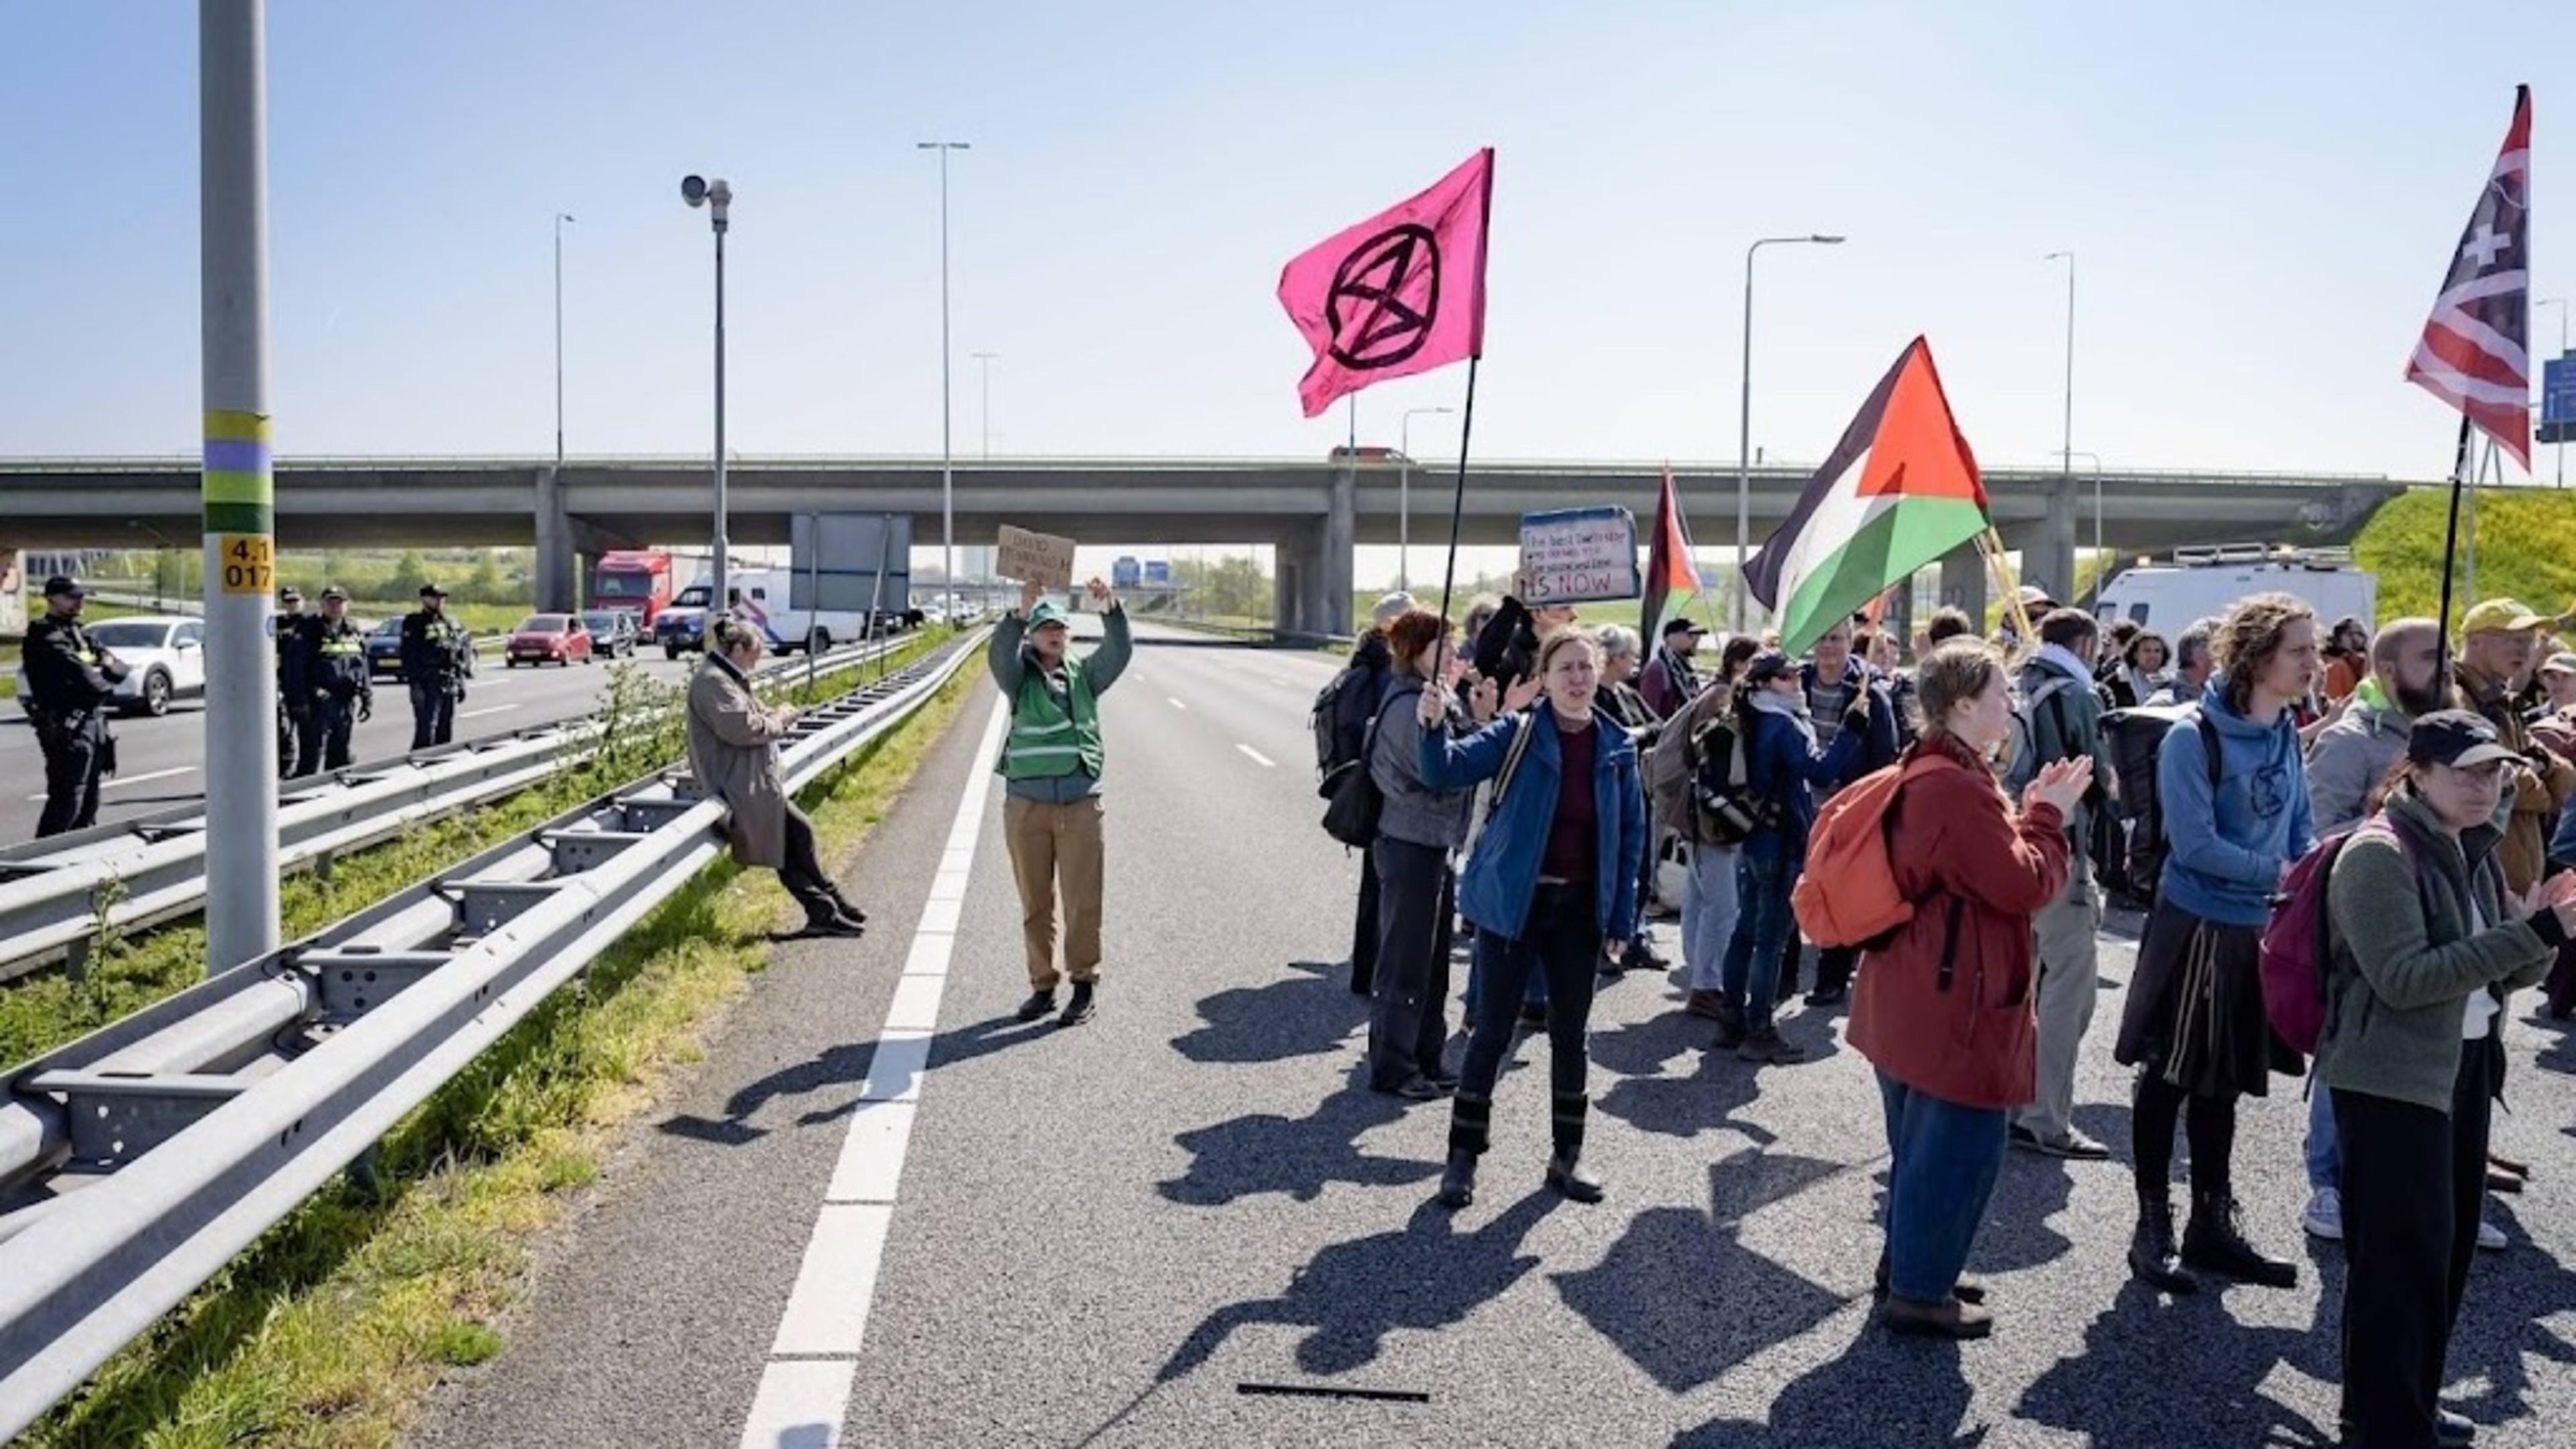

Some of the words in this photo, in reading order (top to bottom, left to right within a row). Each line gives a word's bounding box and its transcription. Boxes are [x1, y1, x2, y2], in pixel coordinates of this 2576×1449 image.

[231, 539, 268, 561] 4.1
[225, 565, 270, 586] 017
[1559, 572, 1611, 594] NOW
